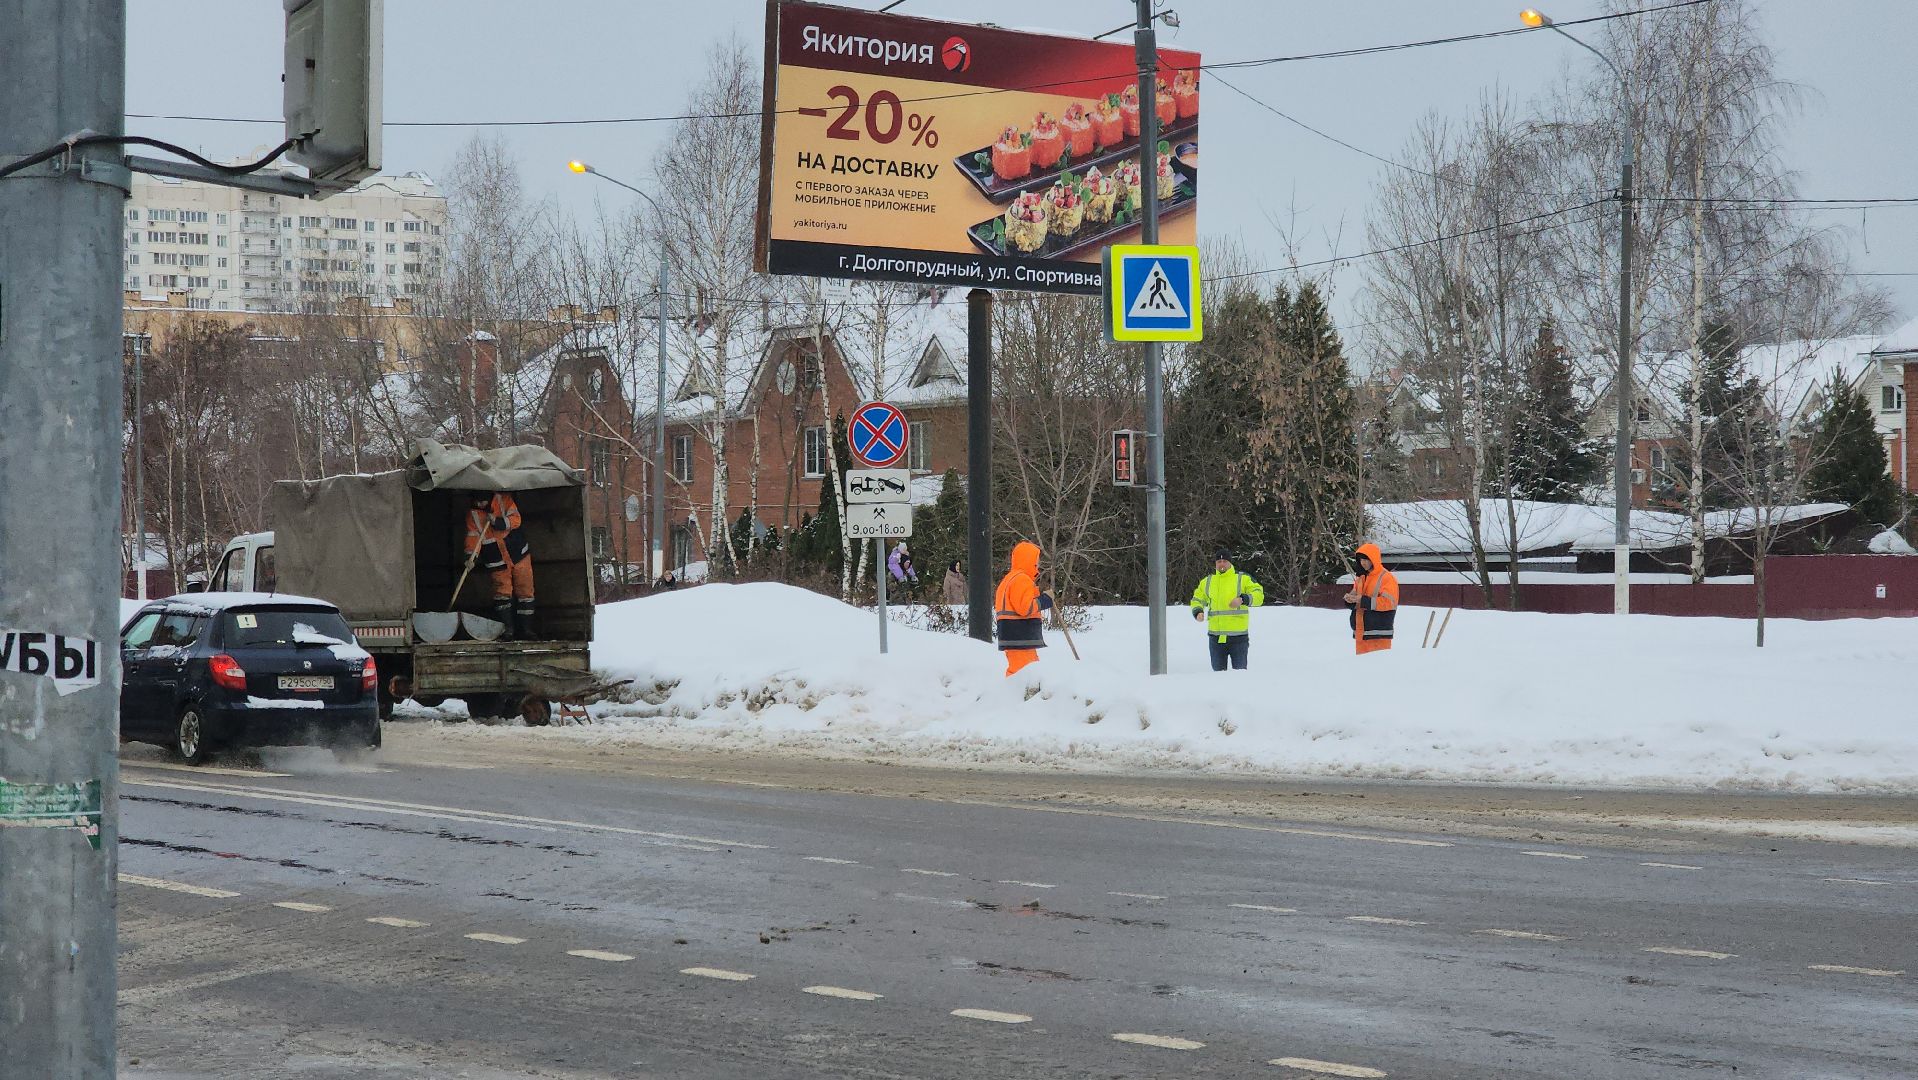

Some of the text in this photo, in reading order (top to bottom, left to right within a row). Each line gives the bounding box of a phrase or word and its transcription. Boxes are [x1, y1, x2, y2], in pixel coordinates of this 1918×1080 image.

[802, 25, 934, 66] Якитория
[797, 151, 939, 180] НА ДОСТАВКУ
[795, 180, 929, 200] С ПЕРВОГО ЗАКАЗА ЧЕРЕЗ
[794, 194, 936, 214] МОБИЛЬНОЕ ПРИЛОЖЕНИЕ
[793, 219, 848, 231] yakitoriya.ru
[839, 254, 1102, 288] г. Долгопрудный, ул. Спортивна
[852, 523, 906, 535] 9.00-18.00
